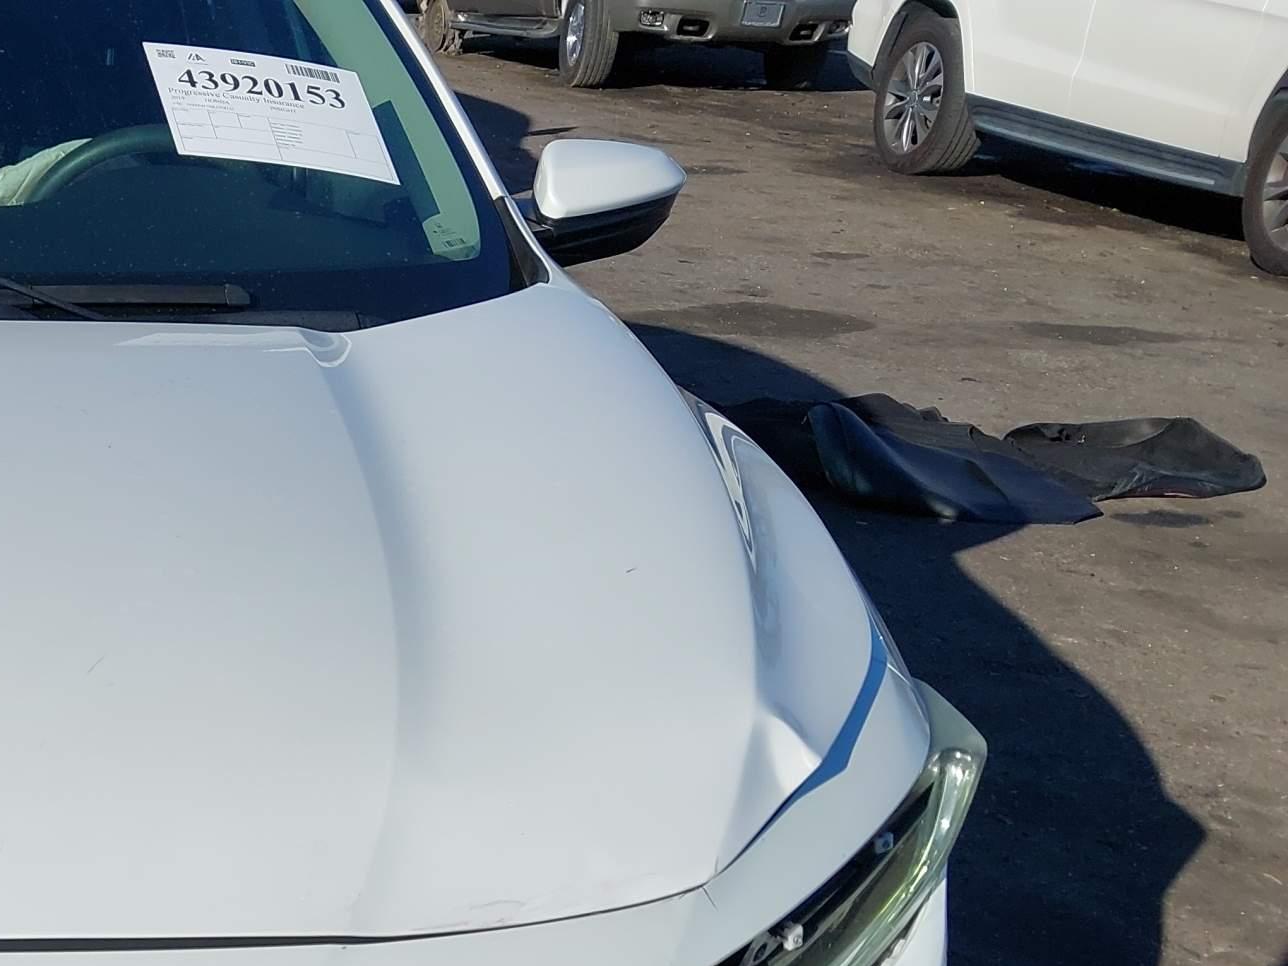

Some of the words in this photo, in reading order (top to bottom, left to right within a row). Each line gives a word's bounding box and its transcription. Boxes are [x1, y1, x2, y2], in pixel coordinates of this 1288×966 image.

[168, 87, 221, 98] Progressive
[263, 97, 305, 109] Insurance
[178, 68, 346, 110] 43920153
